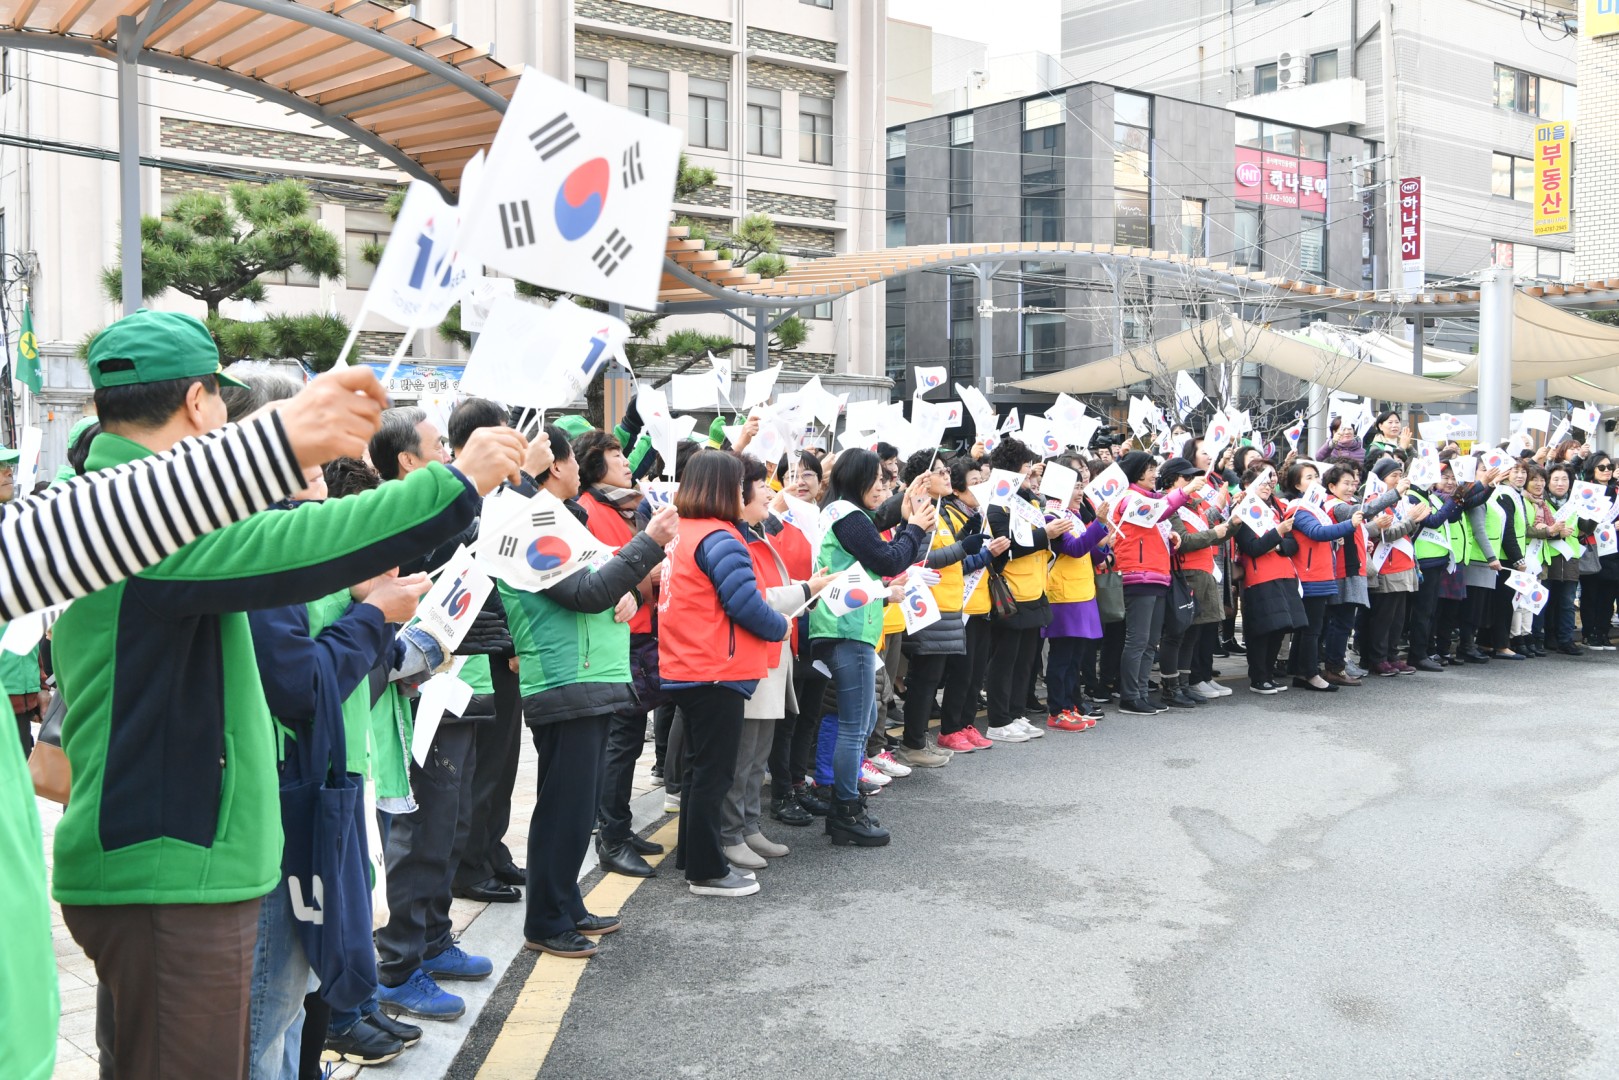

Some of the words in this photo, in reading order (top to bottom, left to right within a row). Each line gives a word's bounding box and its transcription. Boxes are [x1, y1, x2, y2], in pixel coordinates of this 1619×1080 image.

[1538, 125, 1565, 141] 마을
[1268, 170, 1328, 199] 하나투어
[1541, 143, 1562, 215] 부동산
[1402, 195, 1418, 256] 하나투어
[400, 379, 425, 391] 밝은
